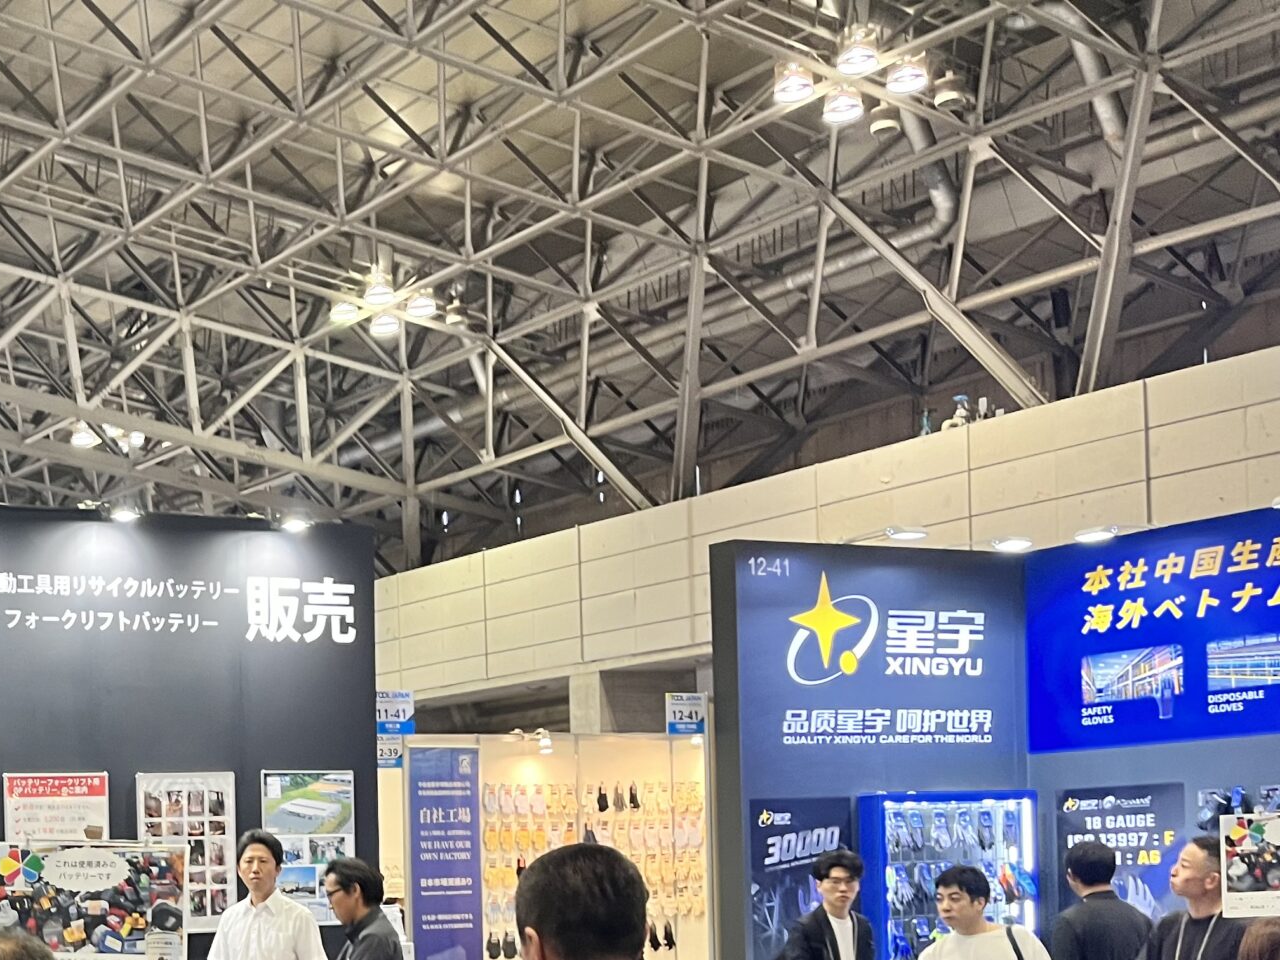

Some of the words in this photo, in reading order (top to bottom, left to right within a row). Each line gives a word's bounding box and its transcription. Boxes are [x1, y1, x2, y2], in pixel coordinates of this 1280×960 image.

[747, 555, 791, 578] 12-41
[245, 575, 357, 645] 販売
[5, 607, 219, 634] フォークリフトバッテリー
[885, 608, 986, 656] 星宇
[884, 656, 984, 677] XINGYU
[1207, 690, 1265, 704] DISPOSABLE
[377, 708, 406, 720] 11-41
[672, 709, 699, 721] 12-41
[1081, 705, 1113, 717] SAFETY
[1208, 702, 1244, 714] GLOVES
[782, 708, 892, 734] 品质星宇
[896, 708, 993, 733] 呵护世界
[1081, 714, 1115, 726] GLOVES
[783, 735, 832, 745] QUALITY
[833, 735, 876, 745] XINGYU
[879, 735, 910, 744] CARE
[910, 735, 935, 744] FOR
[935, 734, 955, 744] THE
[955, 734, 993, 744] WORLD
[419, 807, 472, 825] 自社工場
[1085, 815, 1102, 830] 18
[1105, 813, 1156, 829] GAUGE
[1099, 831, 1149, 849] 13997
[55, 859, 117, 869] これは使用済みの
[59, 872, 112, 880] バッテリーです
